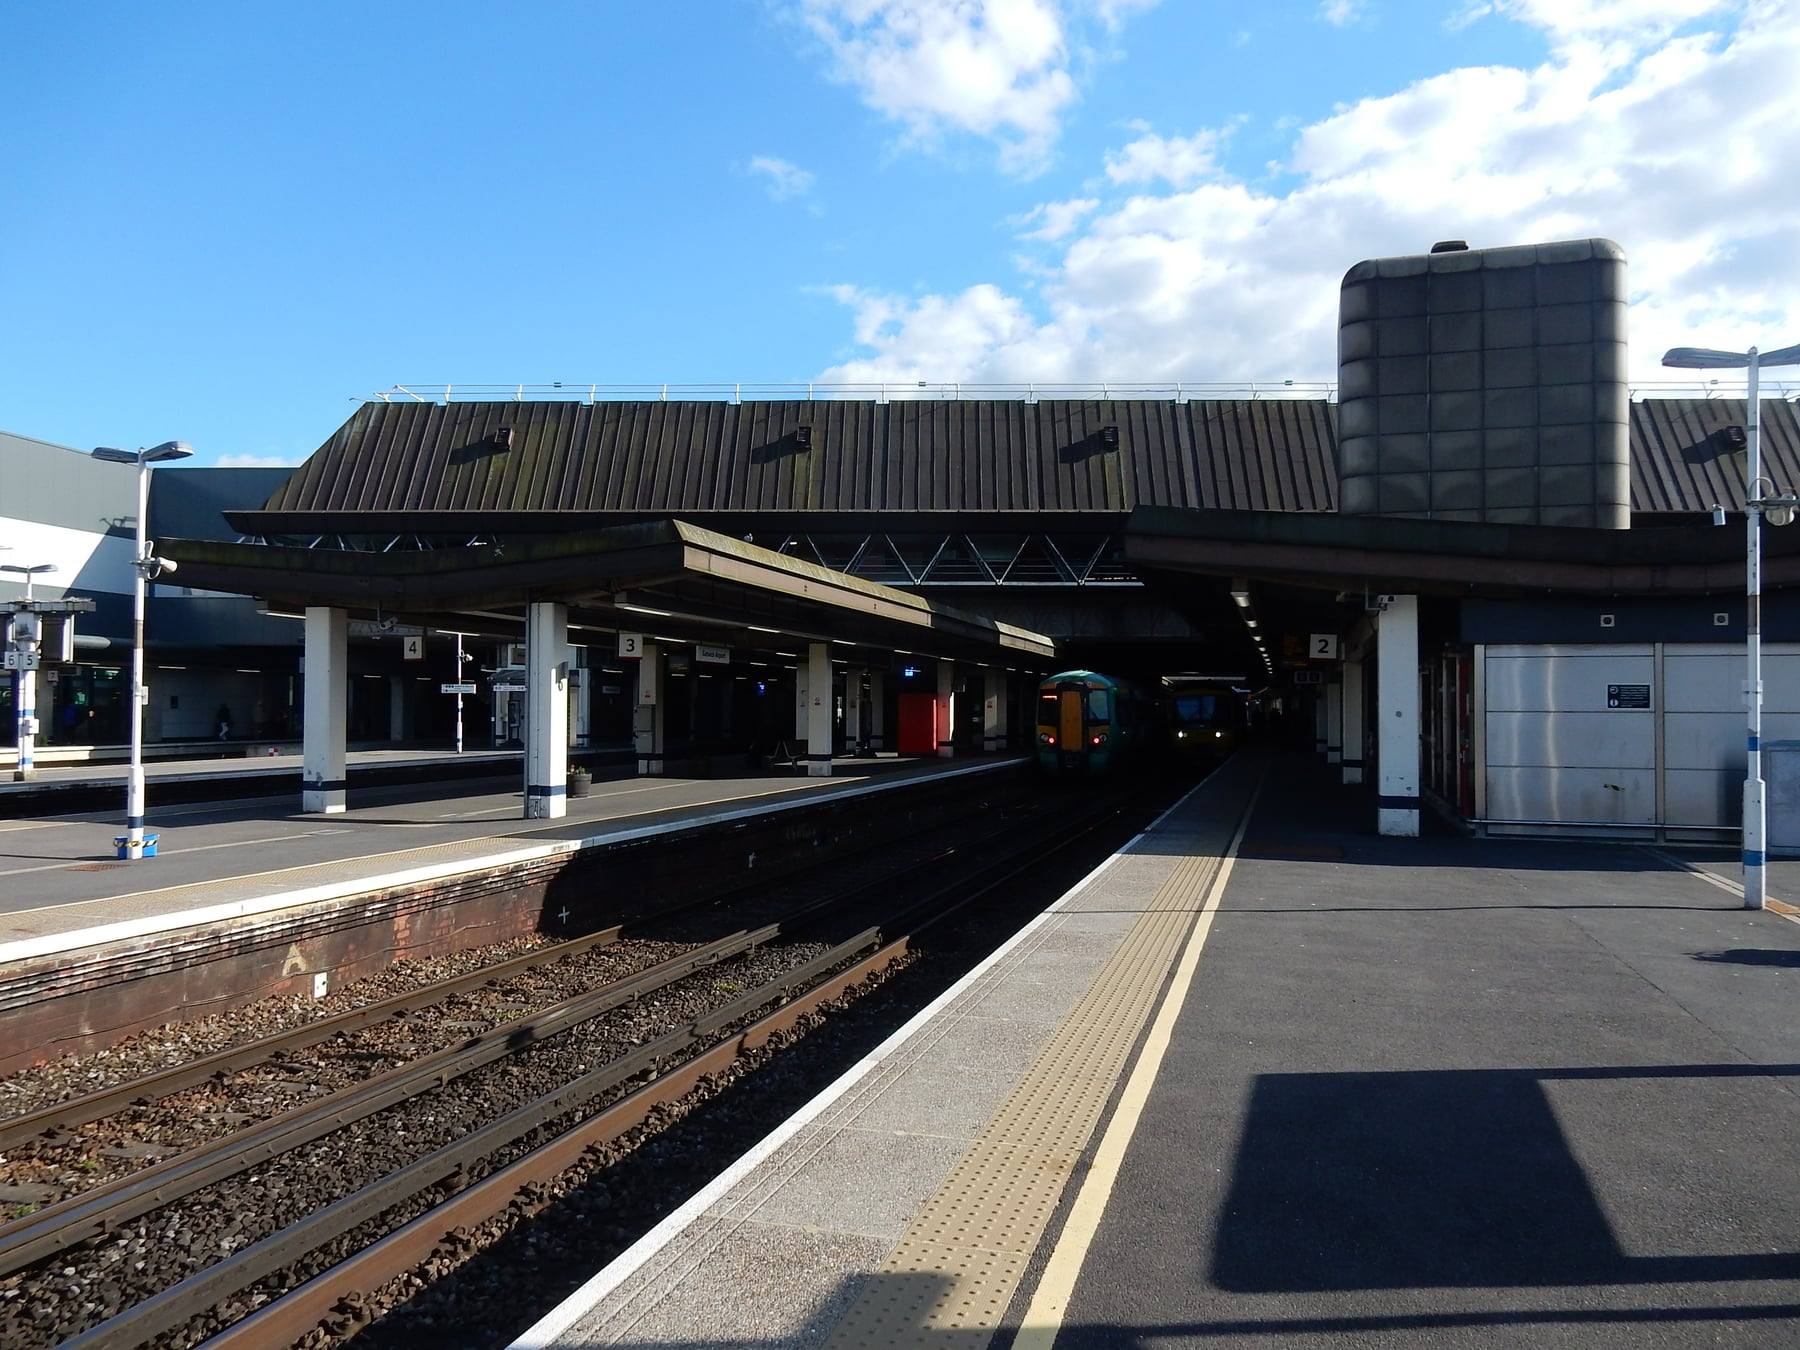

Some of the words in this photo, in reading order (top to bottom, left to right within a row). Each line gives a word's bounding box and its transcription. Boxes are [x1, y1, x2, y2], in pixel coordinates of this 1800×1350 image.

[408, 641, 417, 654] 4
[626, 638, 635, 653] 3
[1318, 639, 1328, 653] 2
[9, 654, 15, 666] 6
[27, 654, 33, 666] 5
